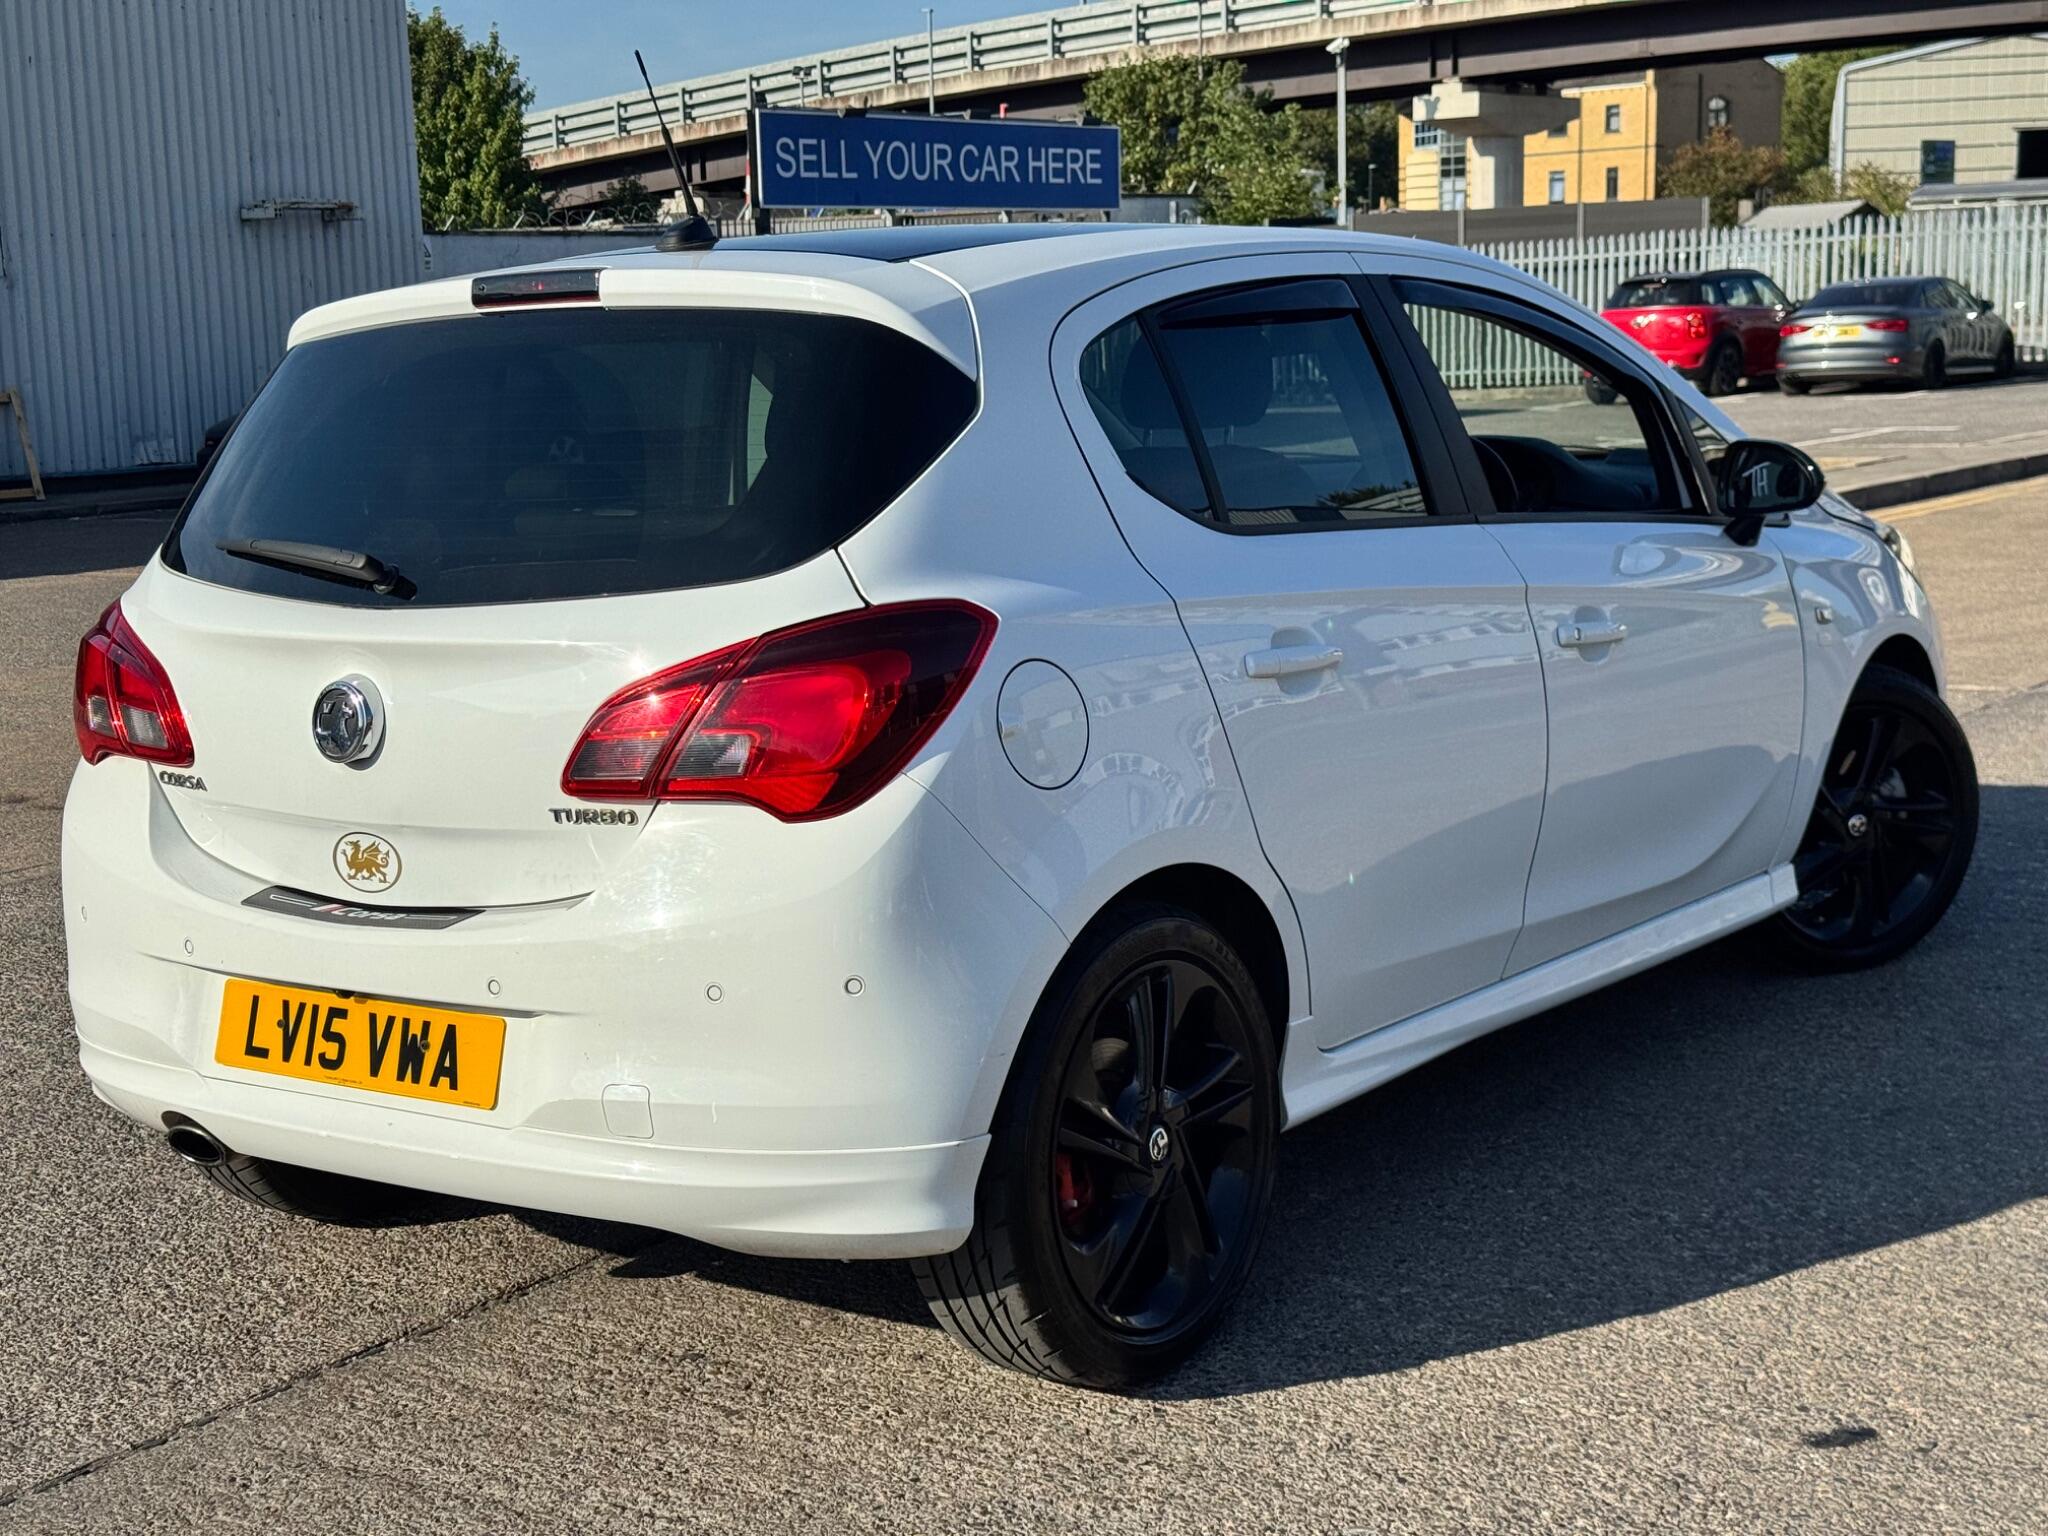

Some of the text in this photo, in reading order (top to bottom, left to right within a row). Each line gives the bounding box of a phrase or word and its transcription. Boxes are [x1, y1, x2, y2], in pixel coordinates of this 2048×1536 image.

[775, 136, 1103, 185] SELL YOUR CAR HERE
[158, 770, 208, 792] CORSA
[547, 807, 639, 826] TURBO
[243, 993, 459, 1091] LV15 VWA
